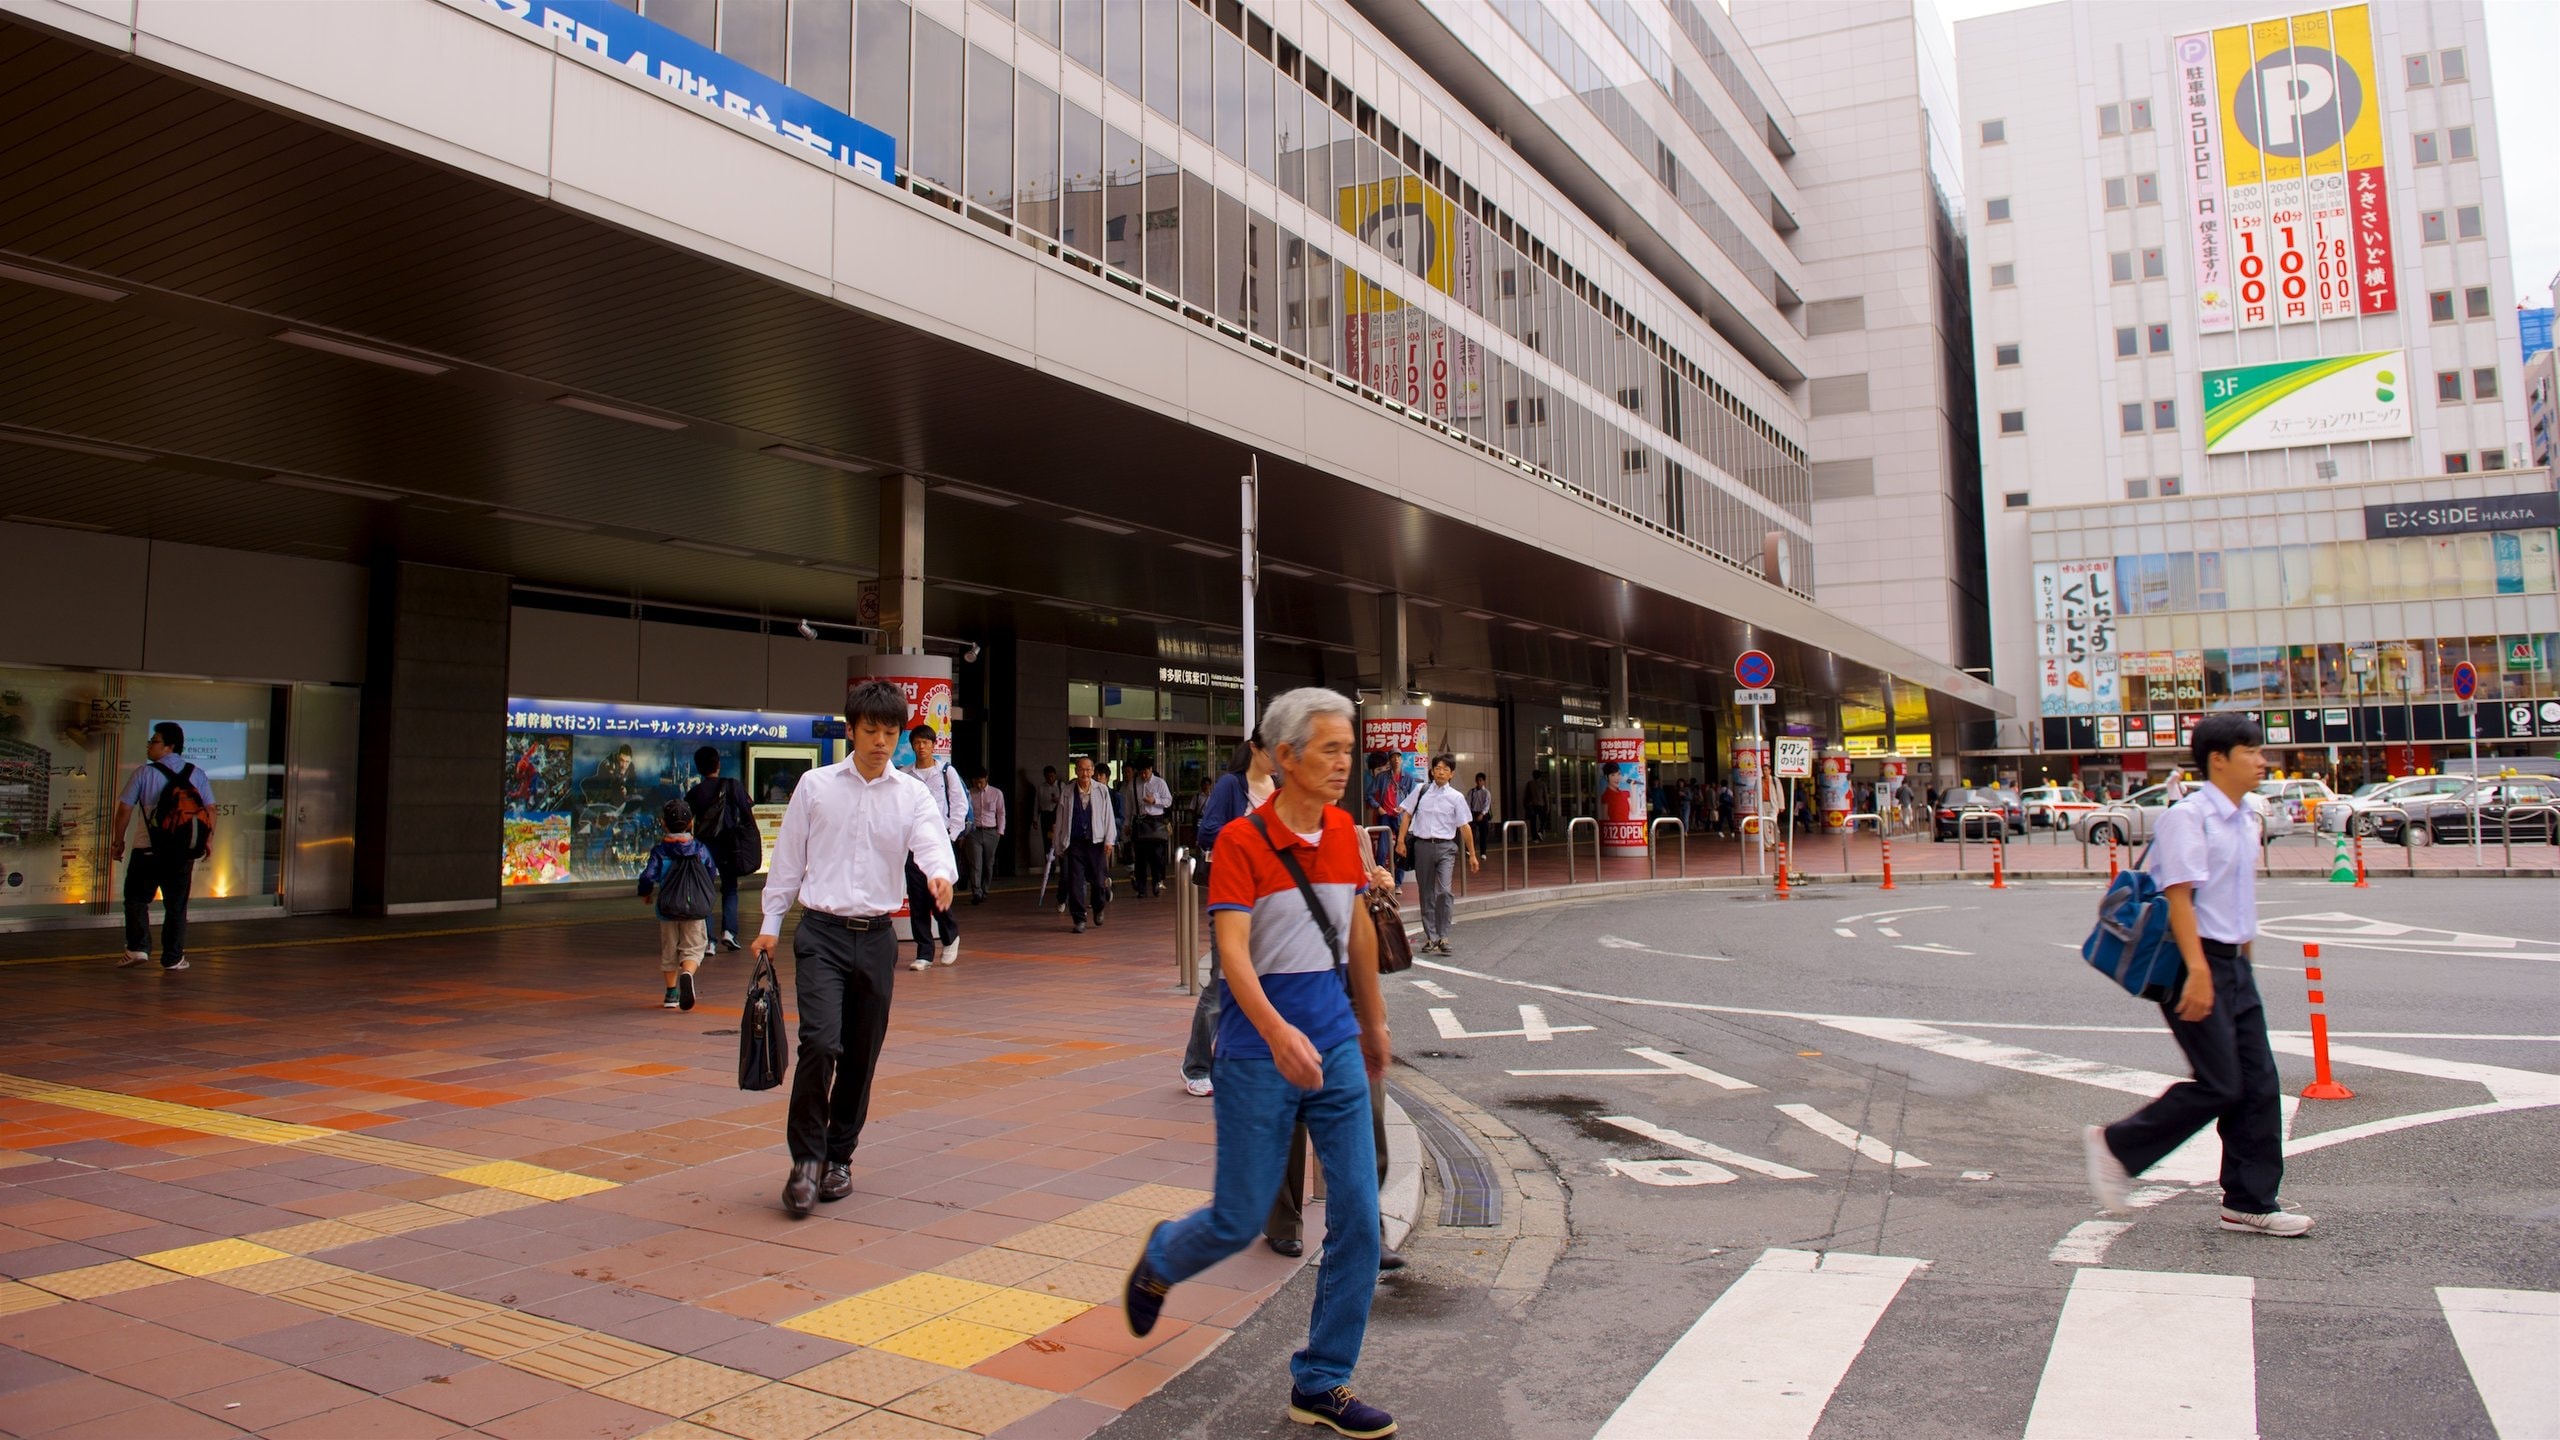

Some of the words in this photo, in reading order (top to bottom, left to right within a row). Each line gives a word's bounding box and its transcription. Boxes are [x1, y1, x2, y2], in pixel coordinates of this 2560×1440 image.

[2262, 63, 2334, 146] P
[2233, 186, 2258, 199] 8:00
[2270, 181, 2300, 194] 20:00
[2231, 201, 2262, 213] 20:00
[2274, 195, 2299, 207] 8:00
[2233, 216, 2262, 229] 15分
[2273, 210, 2302, 224] 60分
[2357, 172, 2388, 309] えきさいど横丁
[2213, 377, 2239, 398] 3F
[2270, 408, 2402, 433] ステーションクリニック
[2385, 507, 2478, 529] EX-SIDE
[2482, 509, 2536, 522] HAKATA
[2090, 573, 2116, 652] しらす
[2062, 584, 2088, 664] くじら
[91, 699, 131, 712] EXE
[1366, 734, 1412, 749] カラオケ
[1601, 749, 1637, 761] カラオケ
[1780, 743, 1808, 755] タクシー
[1620, 826, 1644, 839] OPEN
